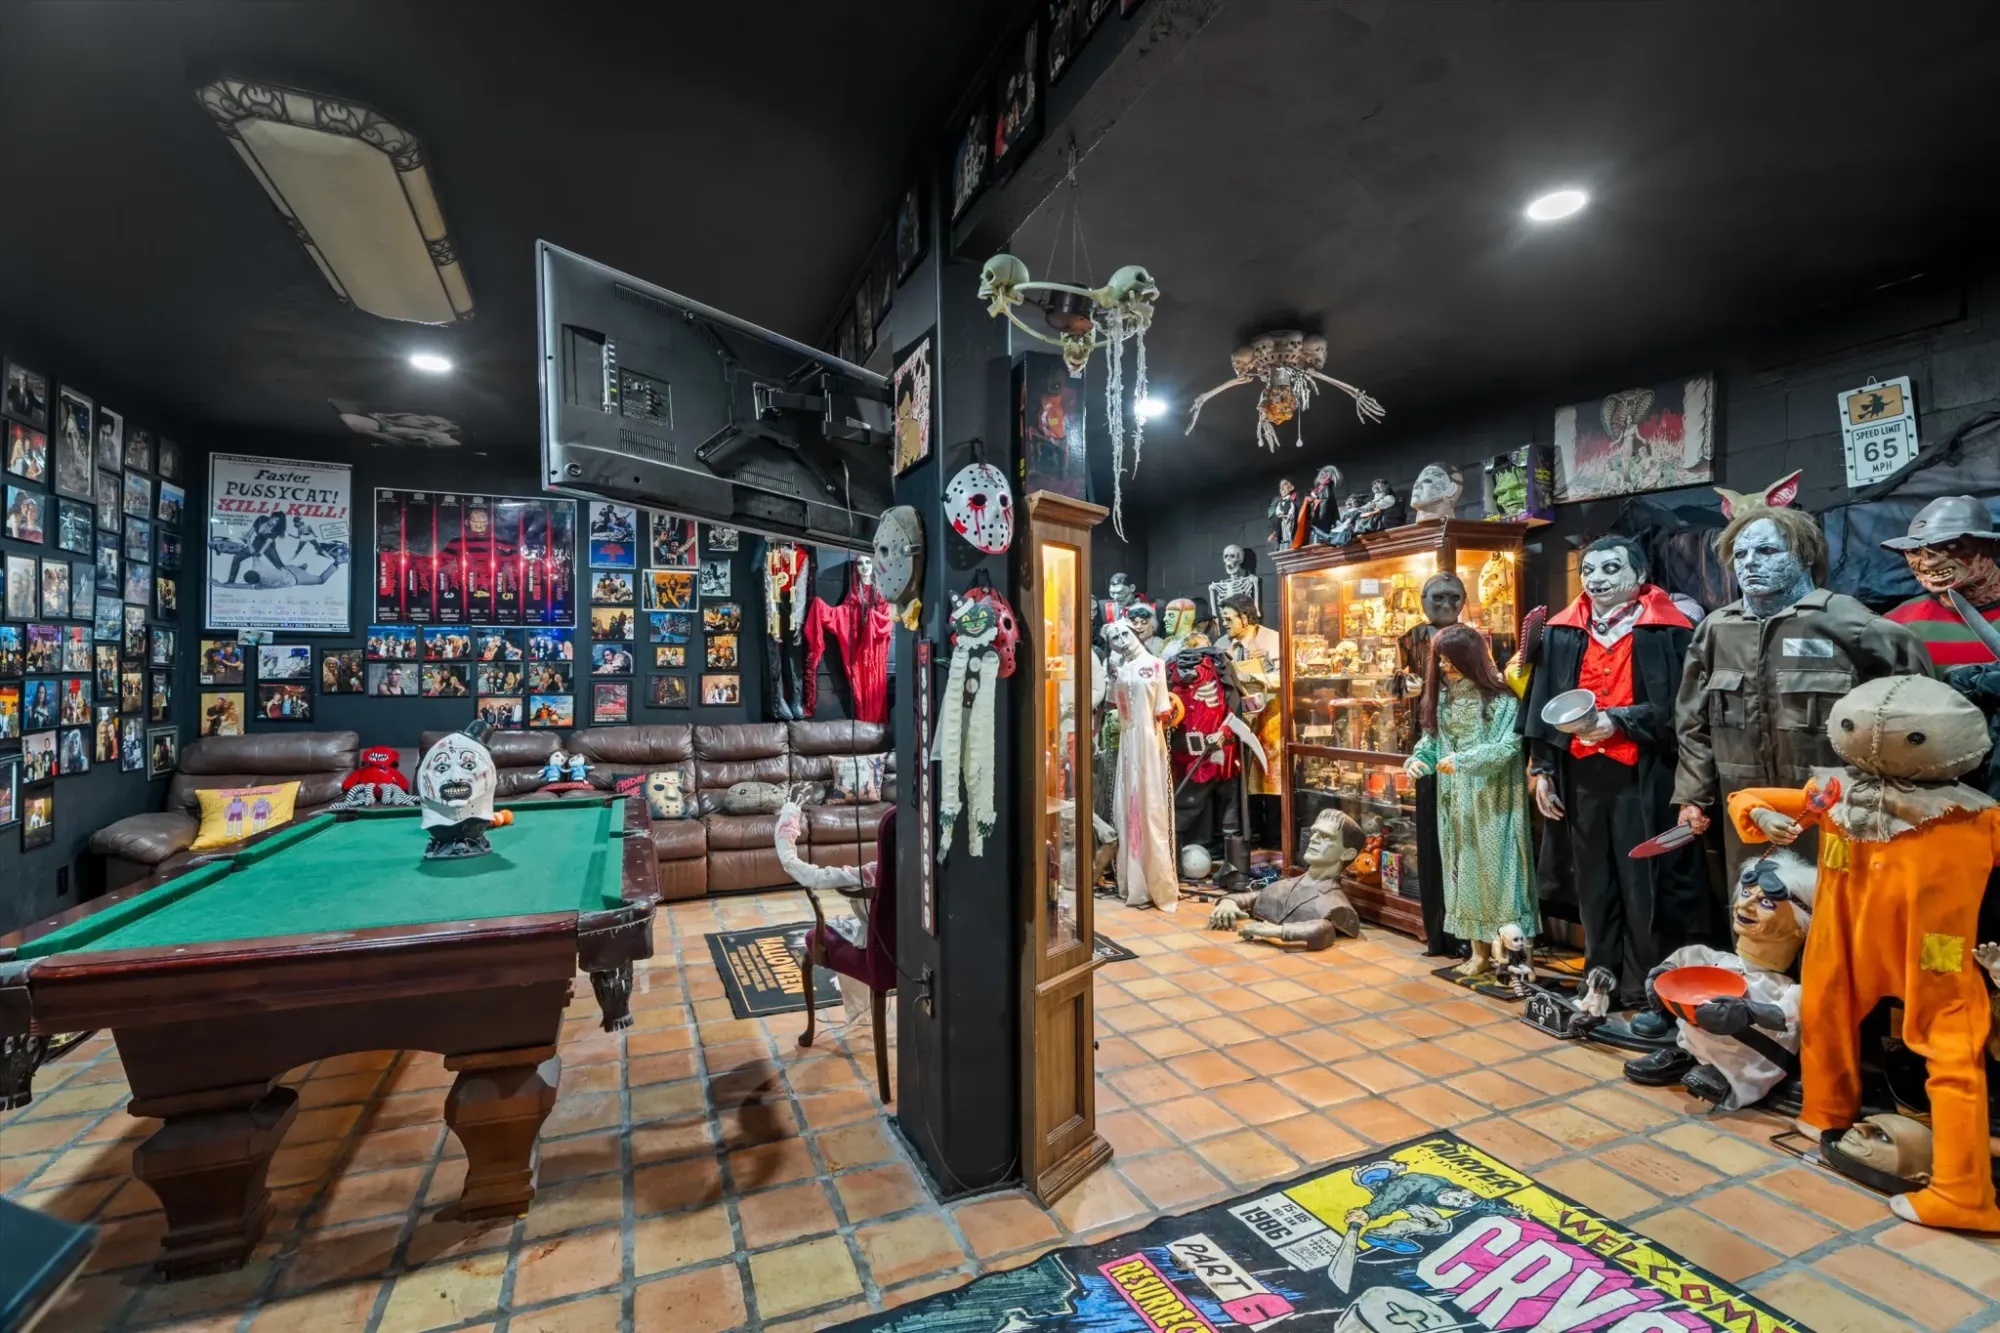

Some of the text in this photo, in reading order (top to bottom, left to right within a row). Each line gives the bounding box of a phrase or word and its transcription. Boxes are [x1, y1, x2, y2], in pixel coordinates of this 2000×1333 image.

[1855, 424, 1901, 440] SPEED LIMIT
[1864, 438, 1898, 462] 65
[254, 469, 311, 485] Faster,
[1872, 461, 1892, 473] MPH
[225, 481, 339, 504] PUSSYCAT!
[216, 498, 348, 519] KILL! KILL!
[616, 772, 647, 792] FRIDAY
[1416, 1148, 1496, 1195] COMICS
[1420, 1142, 1523, 1189] MURDER
[1239, 1206, 1294, 1240] 1986
[1174, 1243, 1253, 1291] PART
[1559, 1210, 1789, 1333] WELCOM
